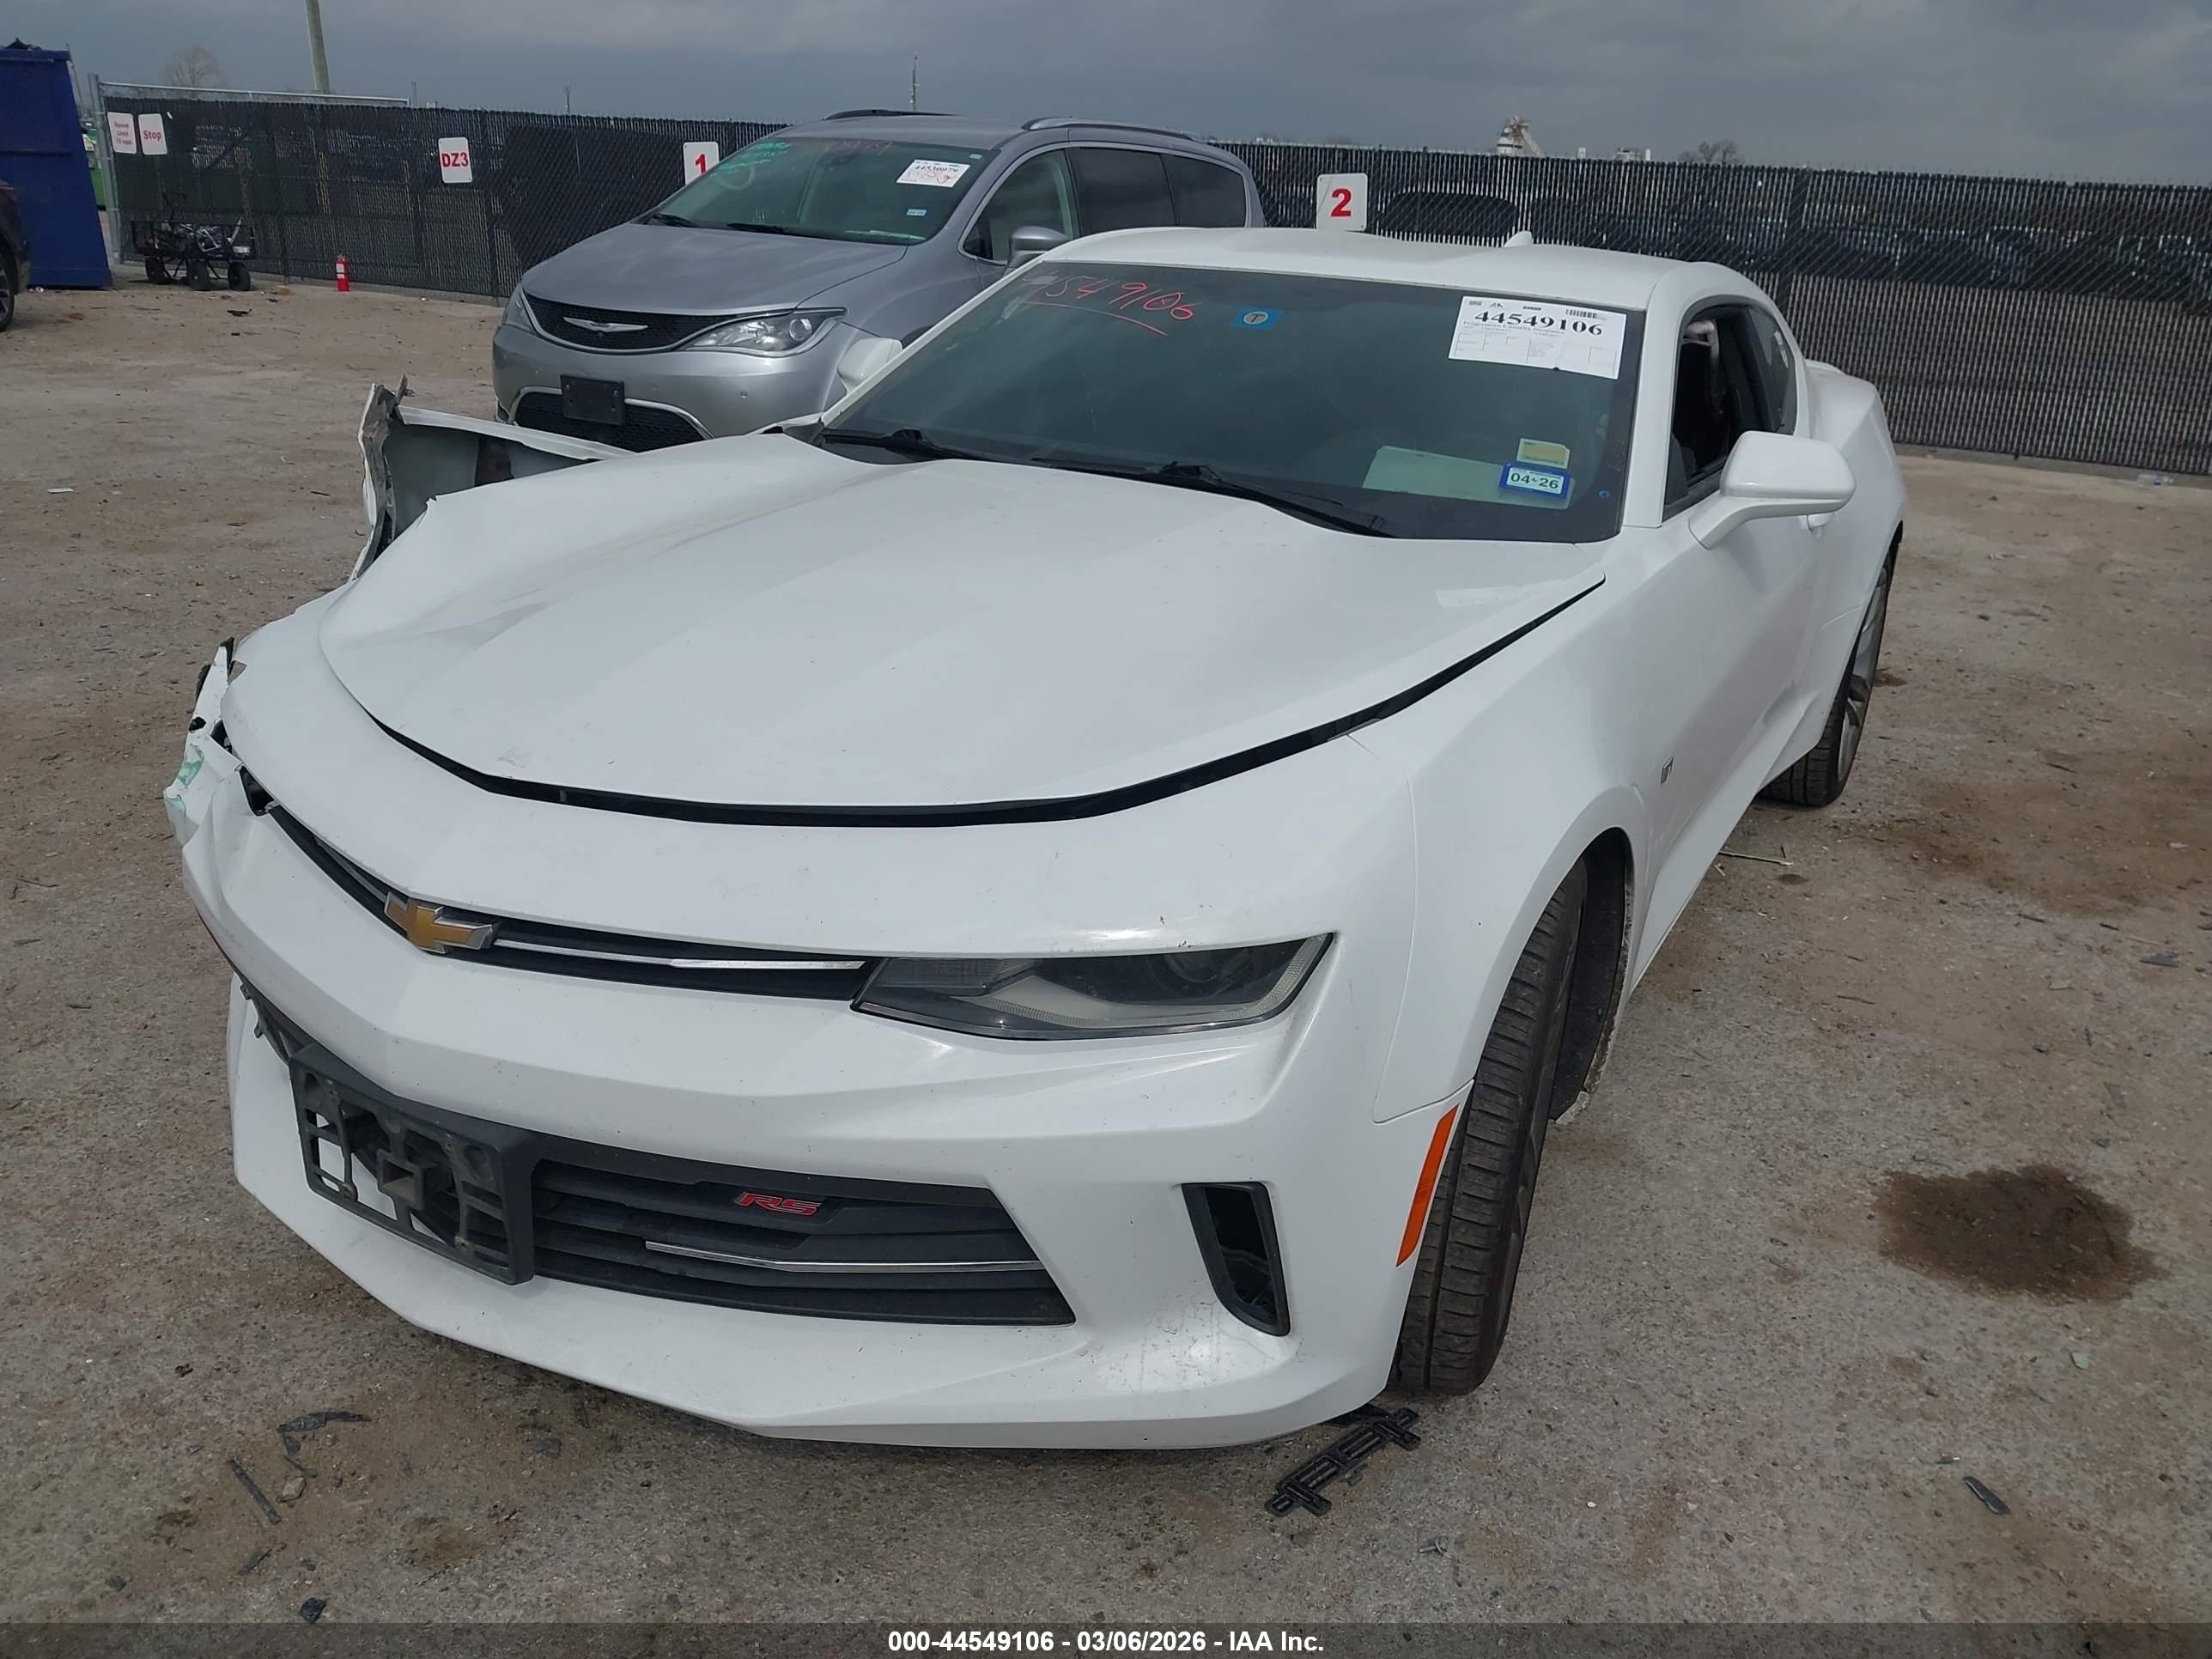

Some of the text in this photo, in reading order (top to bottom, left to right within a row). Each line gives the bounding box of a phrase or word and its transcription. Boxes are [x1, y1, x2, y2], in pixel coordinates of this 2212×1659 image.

[143, 130, 161, 142] Stop
[441, 152, 469, 167] DZ3
[695, 154, 706, 174] 1
[1331, 188, 1352, 217] 2
[1474, 310, 1603, 336] 44549106
[1538, 477, 1559, 489] 26
[734, 1192, 822, 1216] RS
